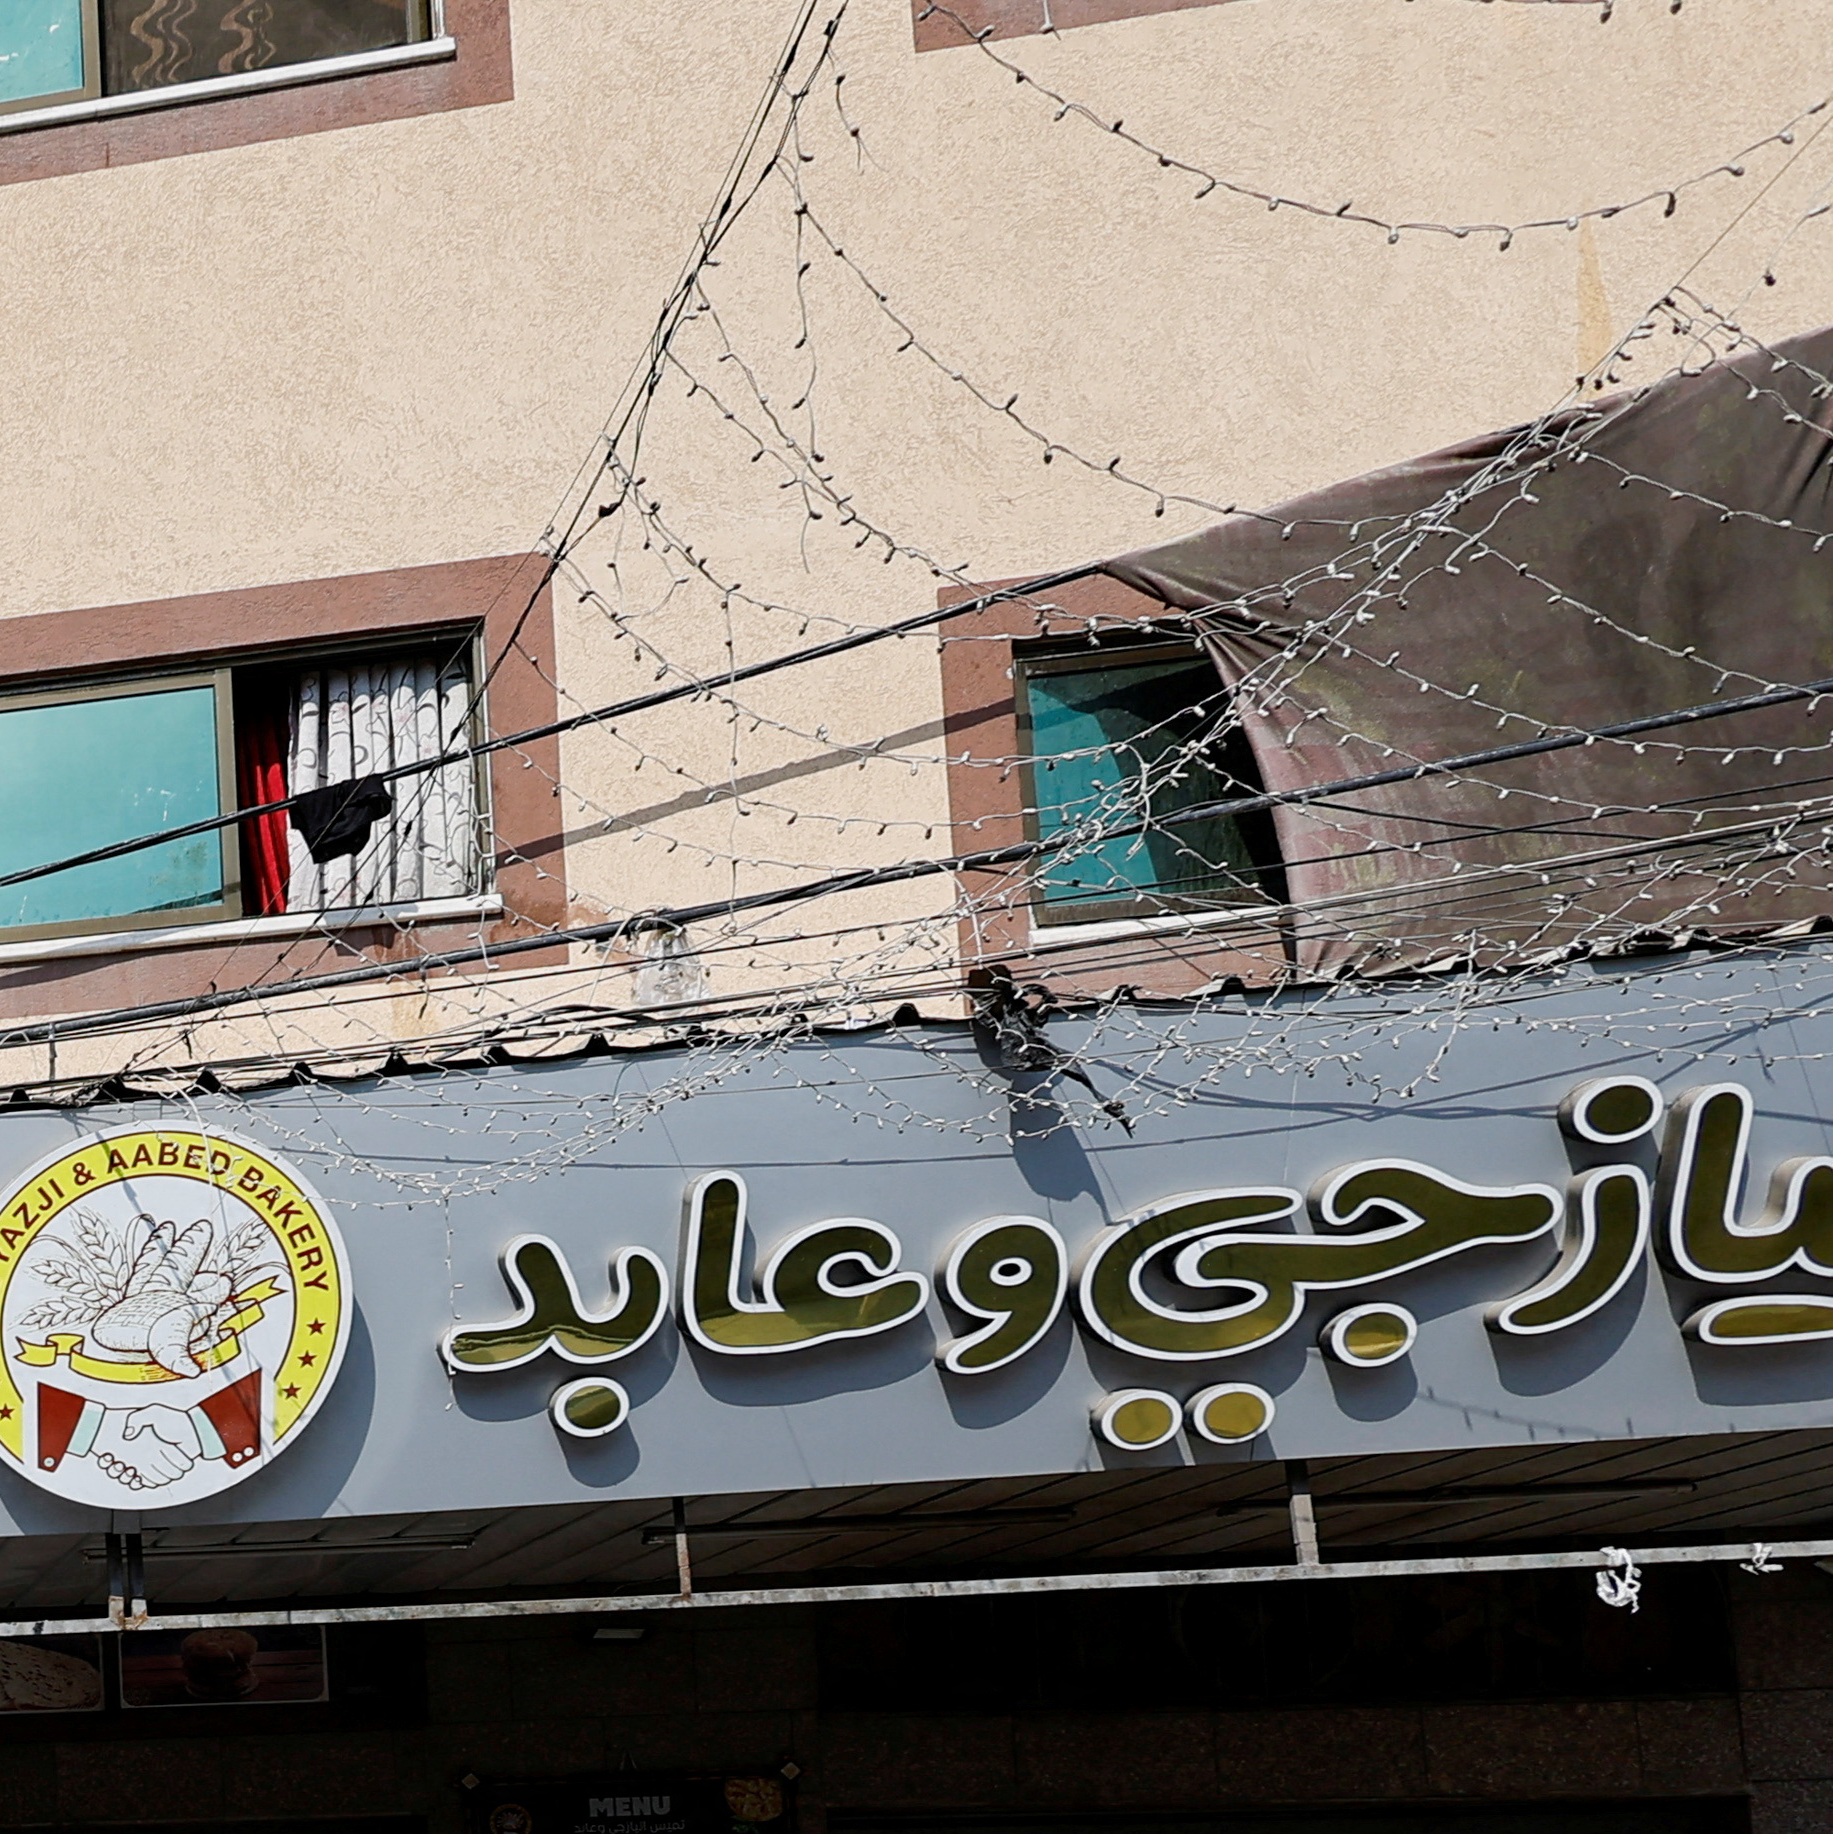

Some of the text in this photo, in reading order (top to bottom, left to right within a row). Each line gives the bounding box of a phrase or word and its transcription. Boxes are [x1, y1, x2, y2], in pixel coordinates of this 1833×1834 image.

[73, 1162, 96, 1186] &
[107, 1142, 232, 1177] AABED
[238, 1166, 330, 1293] BAKERY
[589, 1796, 670, 1817] MENU
